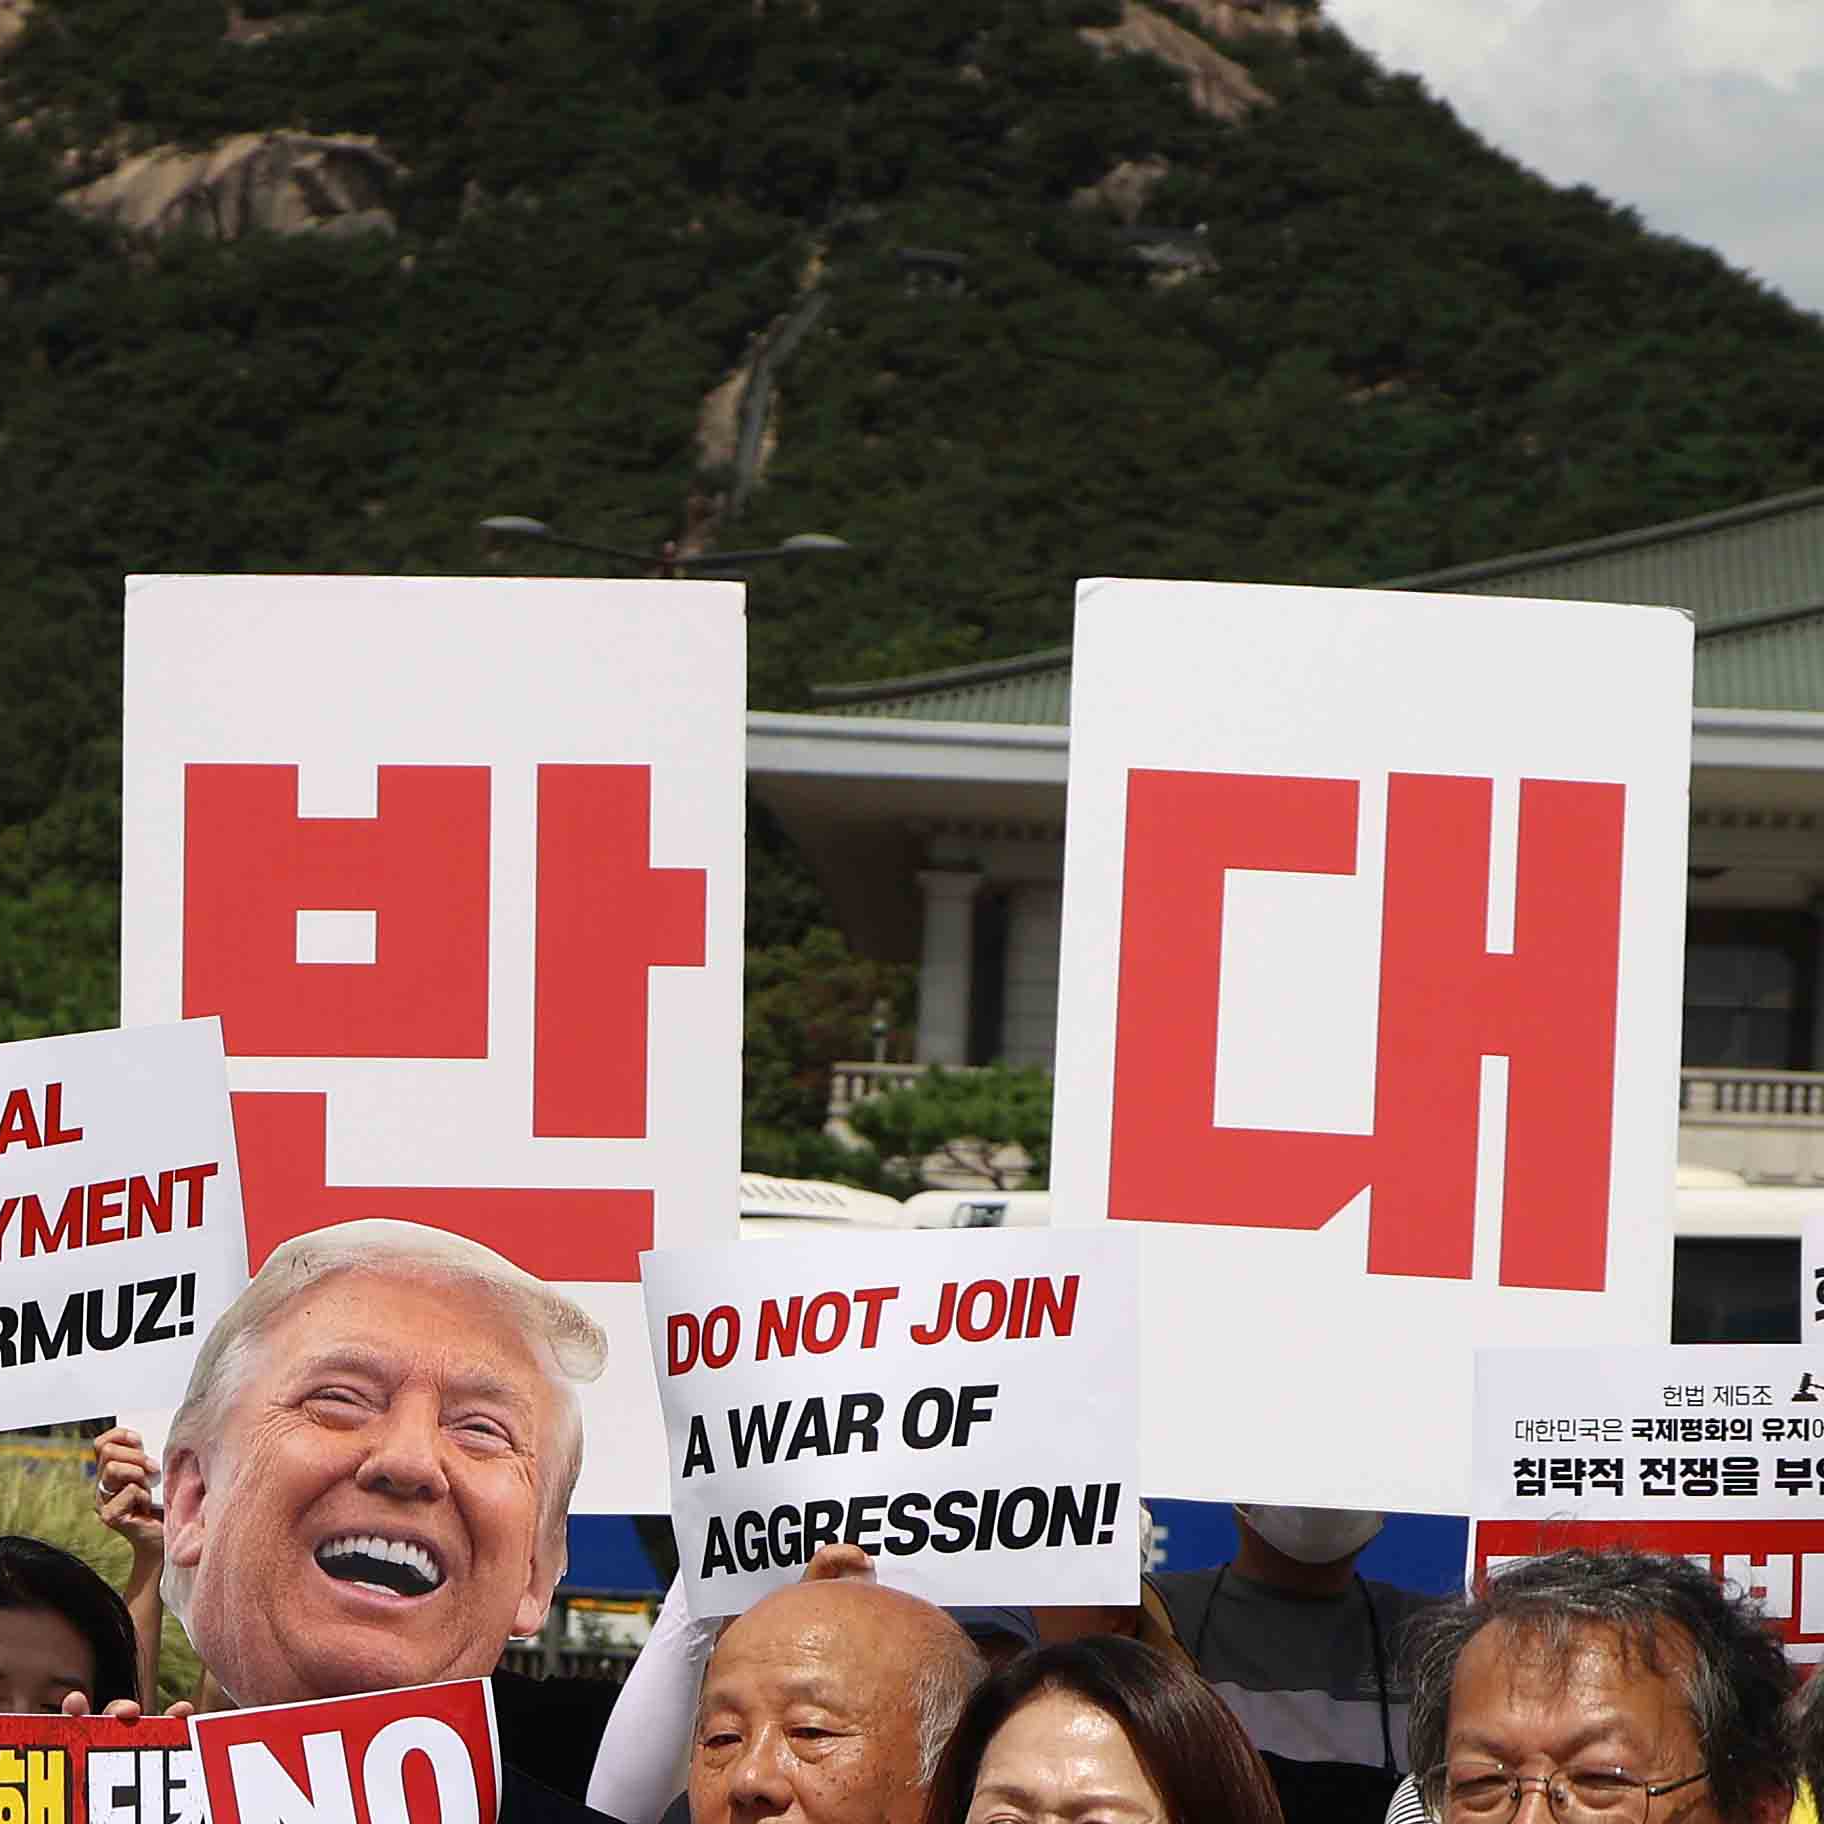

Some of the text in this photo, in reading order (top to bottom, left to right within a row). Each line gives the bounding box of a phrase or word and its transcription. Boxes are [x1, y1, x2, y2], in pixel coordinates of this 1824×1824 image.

[184, 763, 707, 1283] 반
[1108, 769, 1626, 1292] 대
[667, 1274, 1081, 1377] DO NOT JOIN
[681, 1384, 999, 1478] A WAR OF
[1514, 1418, 1624, 1443] 대한민국은
[1631, 1417, 1753, 1442] 국제평화의
[1662, 1384, 1774, 1407] 헌법 제5조
[1513, 1457, 1624, 1497] 침략적
[1638, 1456, 1761, 1497] 전쟁을
[700, 1482, 1122, 1580] AGGRESSION!
